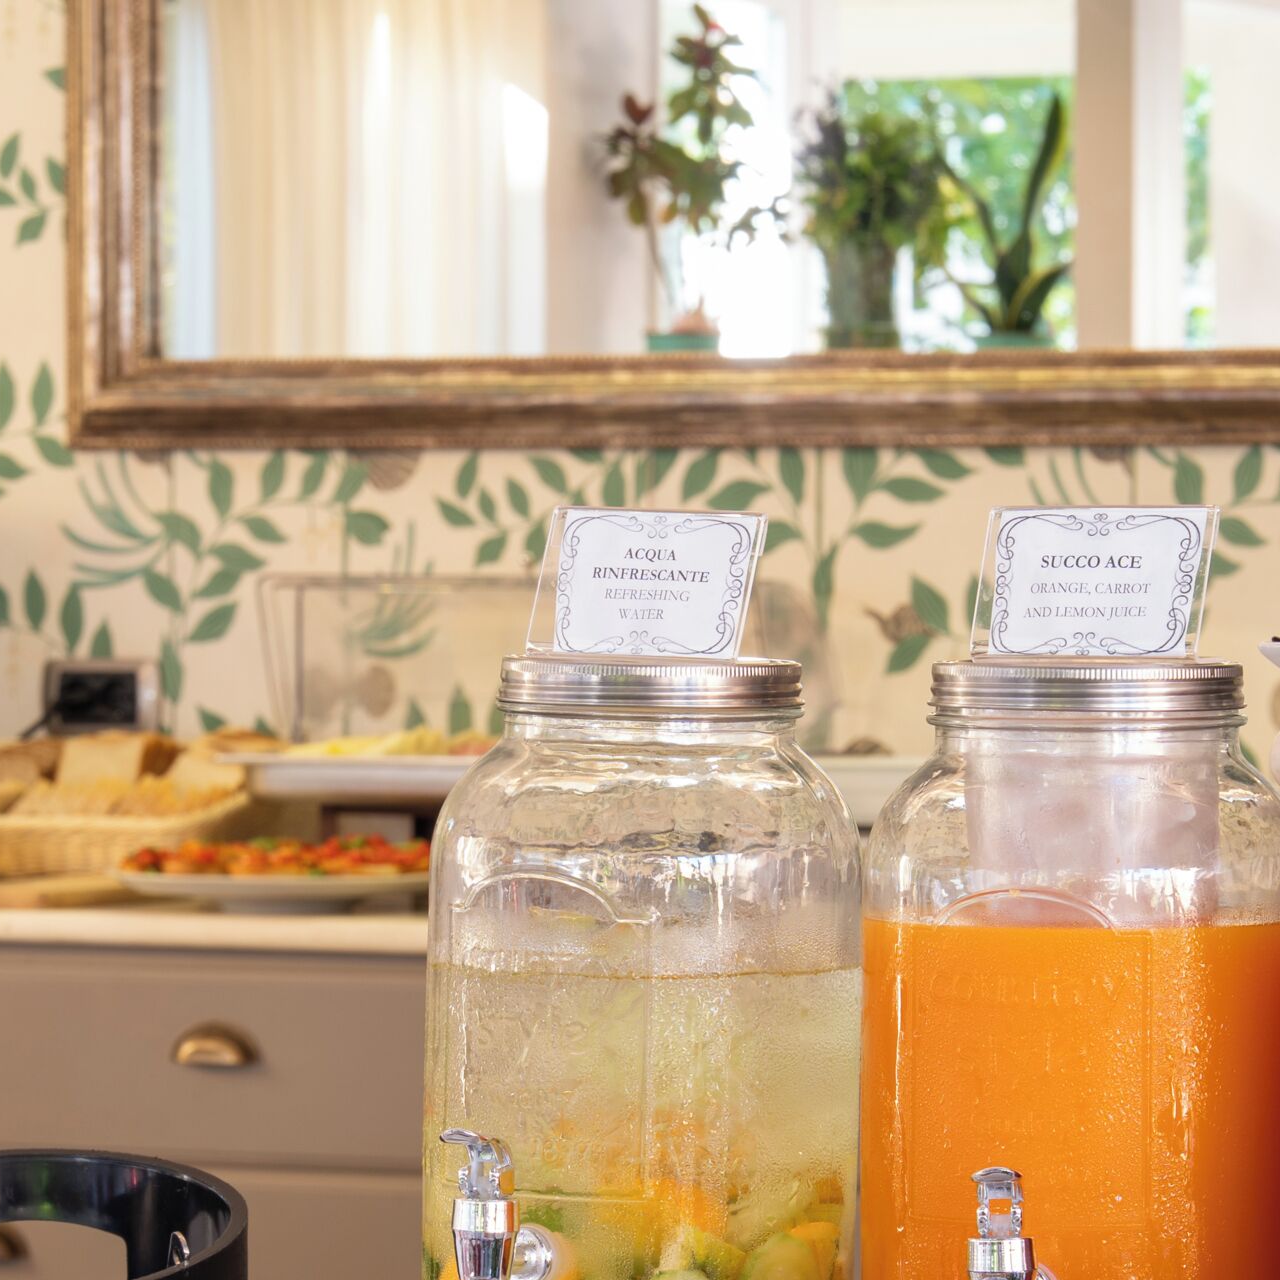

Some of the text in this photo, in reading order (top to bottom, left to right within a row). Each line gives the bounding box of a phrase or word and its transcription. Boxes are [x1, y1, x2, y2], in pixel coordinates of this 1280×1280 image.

[624, 547, 677, 563] ACQUA
[1040, 555, 1142, 569] SUCCO ACE
[592, 566, 710, 583] RINFRESCANTE
[604, 587, 690, 602] REFRESHING
[1030, 582, 1151, 596] ORANGE, CARROT
[618, 607, 664, 620] WATER
[1023, 606, 1148, 621] AND LEMON JUICE
